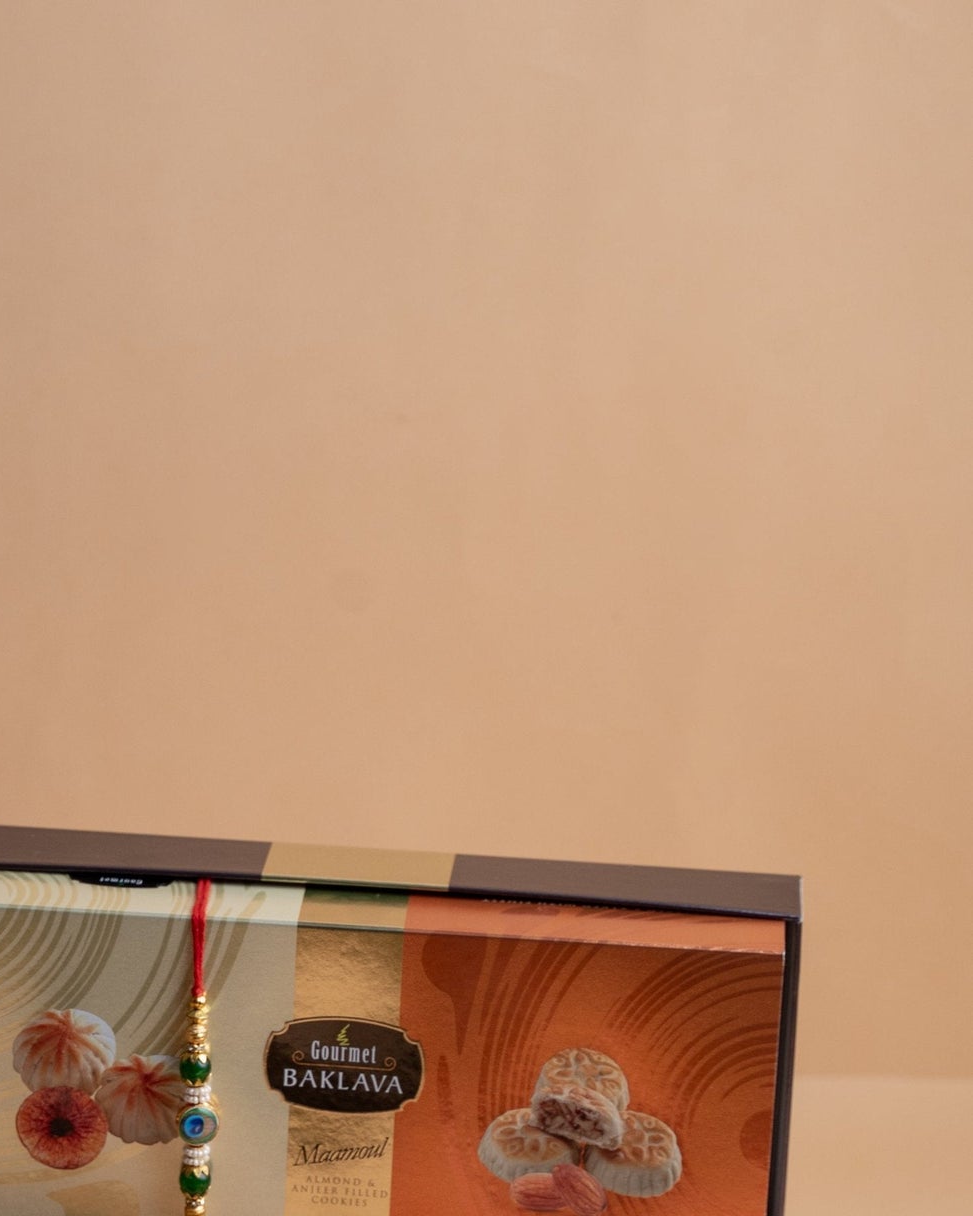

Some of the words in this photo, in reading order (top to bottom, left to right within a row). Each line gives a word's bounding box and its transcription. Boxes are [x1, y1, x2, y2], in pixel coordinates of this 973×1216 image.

[311, 1040, 377, 1064] Gourmet
[283, 1068, 403, 1094] BAKLAVA
[292, 1137, 389, 1166] Maamoul
[306, 1175, 362, 1186] ALMOND
[367, 1178, 376, 1187] &
[291, 1184, 338, 1195] ANJEER
[345, 1187, 388, 1199] FILLED
[311, 1196, 367, 1207] COOKIES
